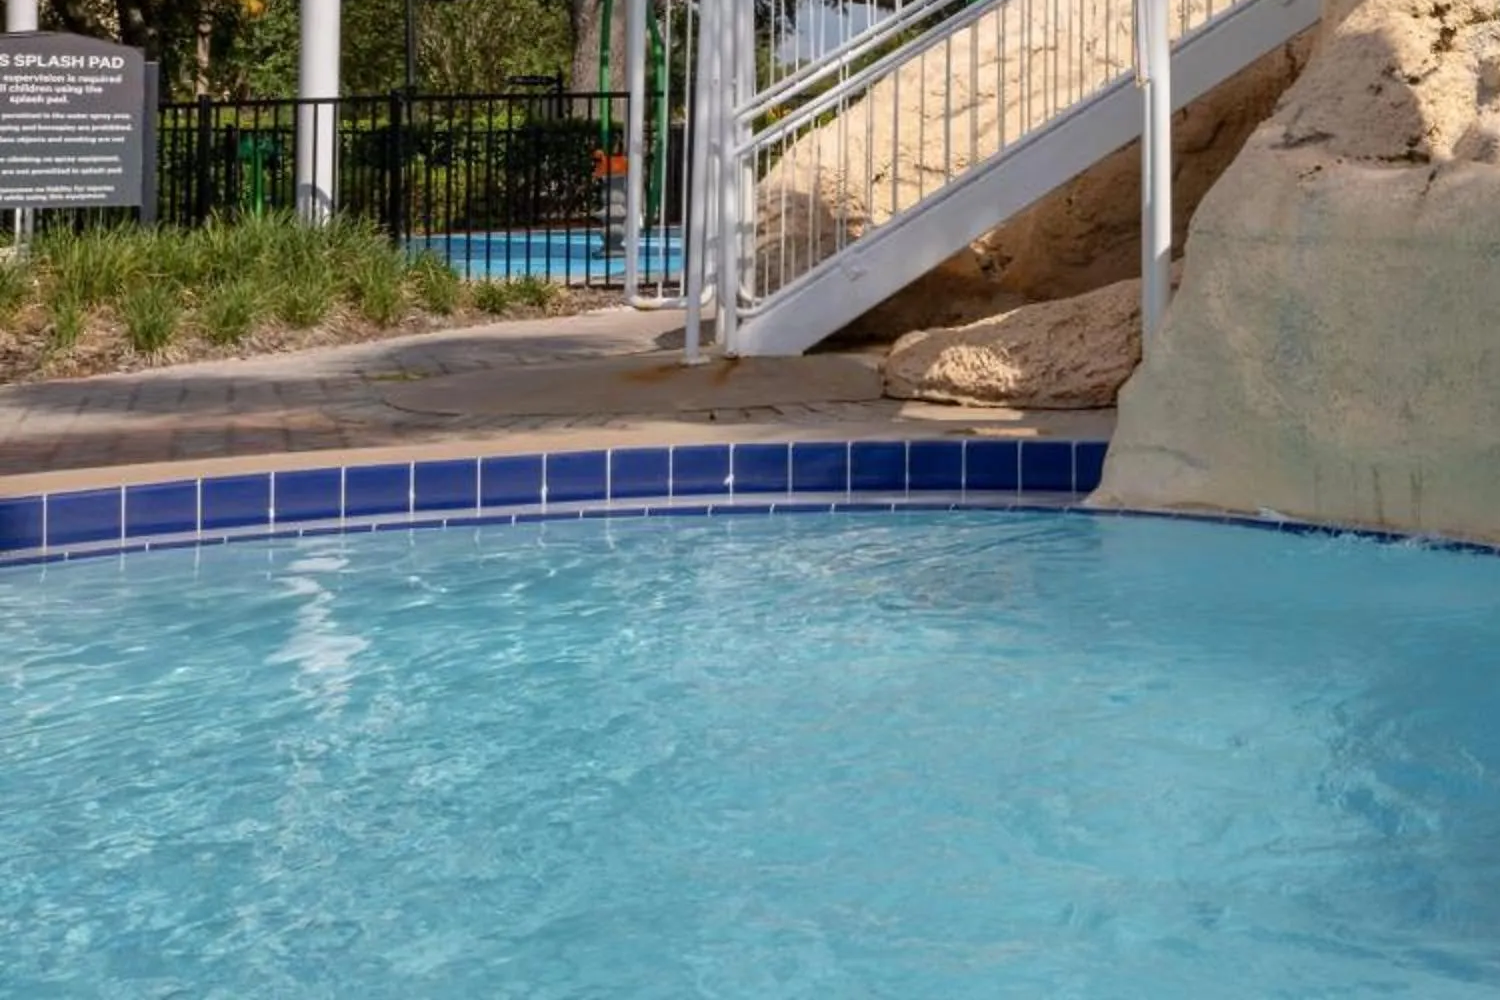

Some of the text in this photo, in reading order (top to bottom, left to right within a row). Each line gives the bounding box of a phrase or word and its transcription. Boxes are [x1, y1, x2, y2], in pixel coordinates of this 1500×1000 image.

[14, 53, 85, 69] SPLASH
[88, 55, 125, 69] PAD
[3, 74, 65, 84] supervision
[78, 74, 122, 84] required
[8, 84, 53, 93] children
[55, 84, 82, 95] using
[85, 85, 103, 93] the
[9, 95, 44, 104] splash
